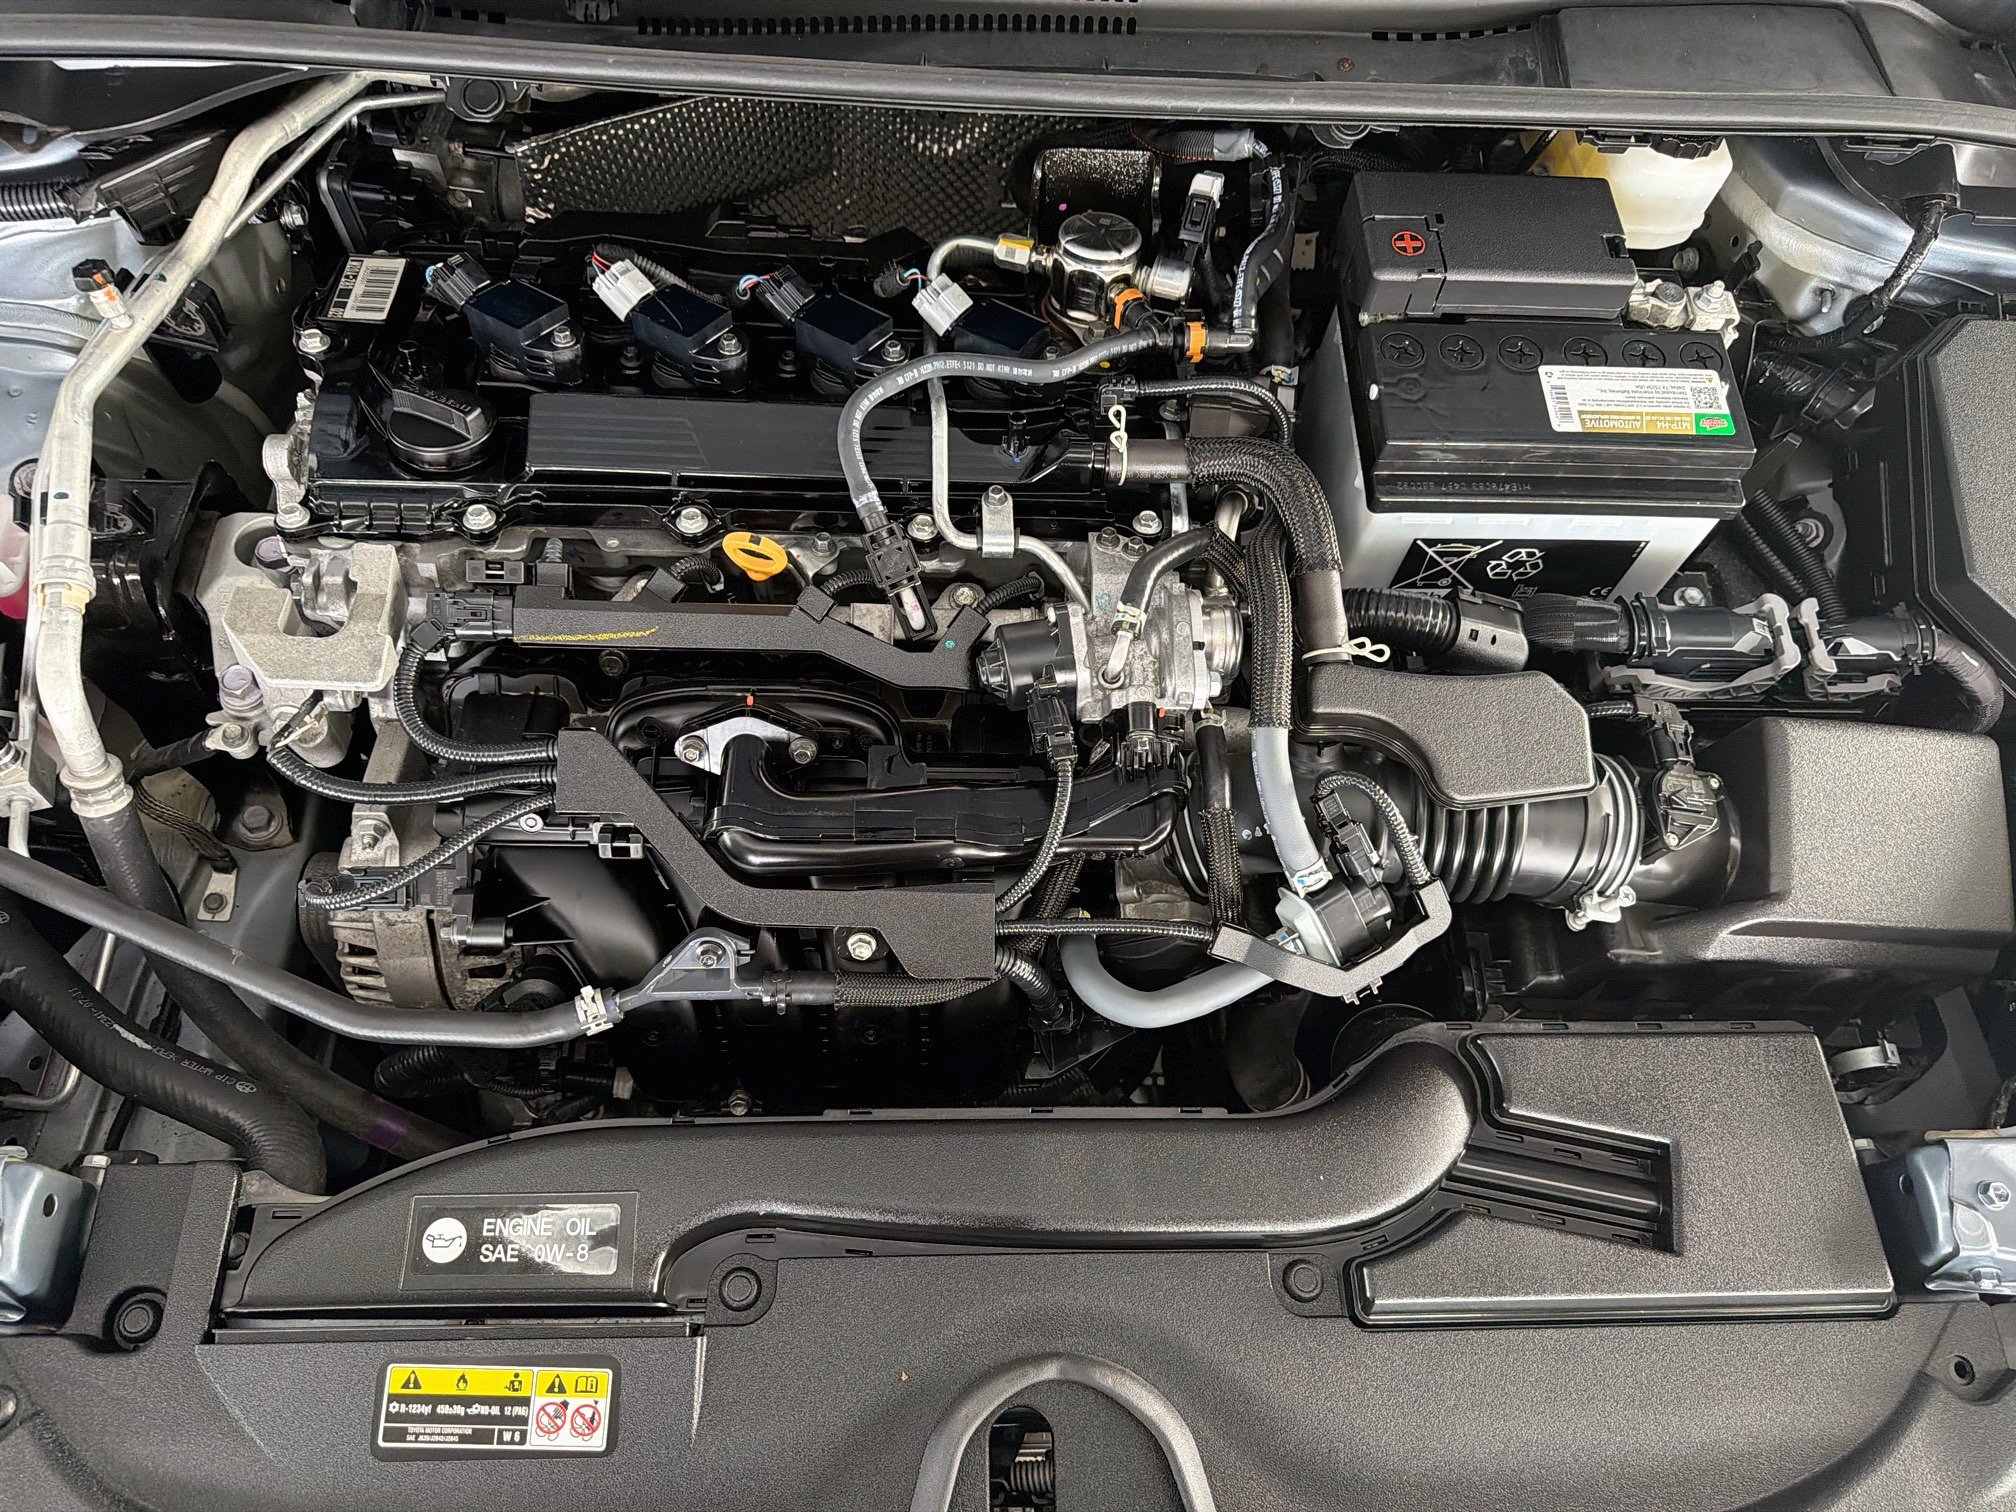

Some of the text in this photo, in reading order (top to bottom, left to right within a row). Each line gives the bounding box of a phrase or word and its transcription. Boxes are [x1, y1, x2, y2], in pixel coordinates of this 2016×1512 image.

[1585, 418, 1642, 429] AUTOMOTIVE
[1656, 421, 1691, 430] MTP-H4
[181, 1058, 214, 1077] WATER
[214, 1073, 236, 1085] CIP
[482, 1217, 597, 1237] ENGINE OIL
[479, 1243, 589, 1263] SAE 0W-8
[399, 1403, 432, 1415] R-1234yf
[436, 1404, 465, 1416] 450±30g
[504, 1406, 512, 1416] 12
[512, 1406, 529, 1417] (PAG)
[502, 1431, 520, 1442] W 6
